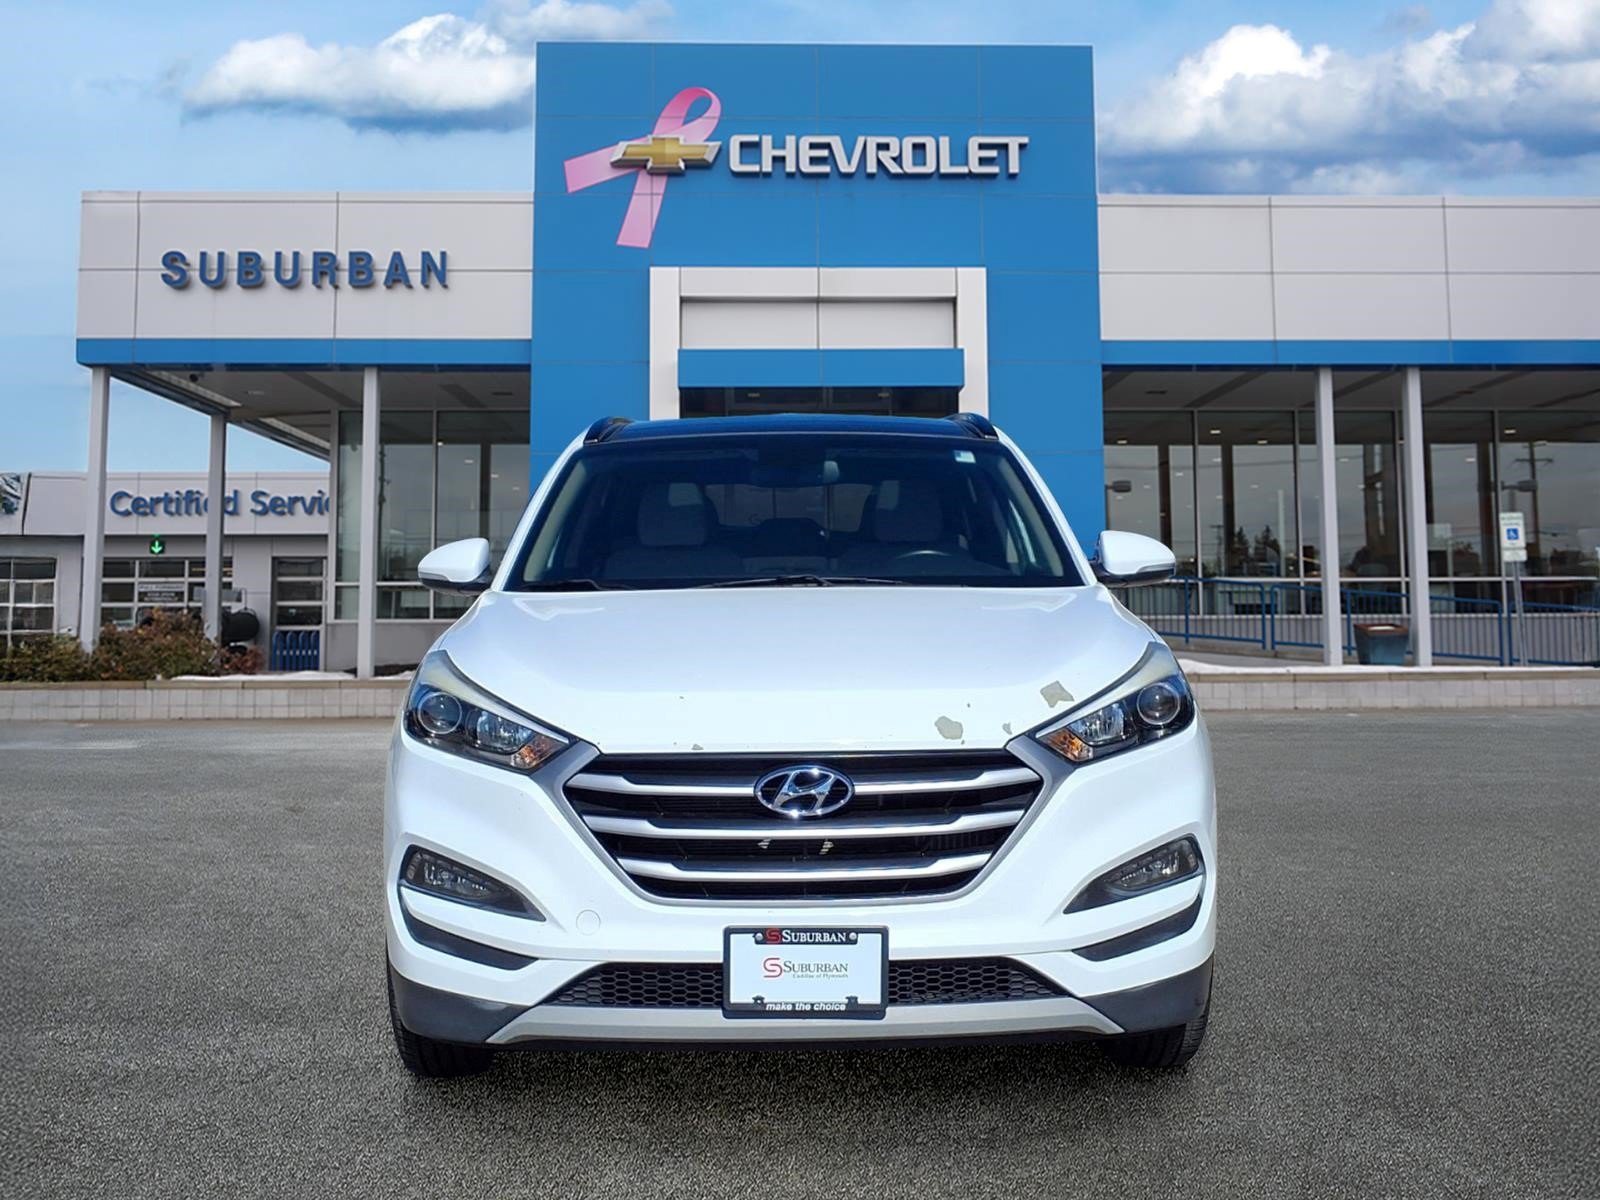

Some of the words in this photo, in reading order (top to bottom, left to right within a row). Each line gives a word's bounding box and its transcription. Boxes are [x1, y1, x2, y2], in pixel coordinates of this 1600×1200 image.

[729, 134, 1029, 175] CHEVROLET
[161, 249, 449, 289] SUBURBAN
[110, 489, 240, 516] Certifid
[782, 929, 847, 943] SUBURBAN
[783, 960, 849, 973] SUBURBAN
[766, 1002, 793, 1011] make
[795, 1002, 811, 1011] the
[813, 1002, 846, 1011] choice
